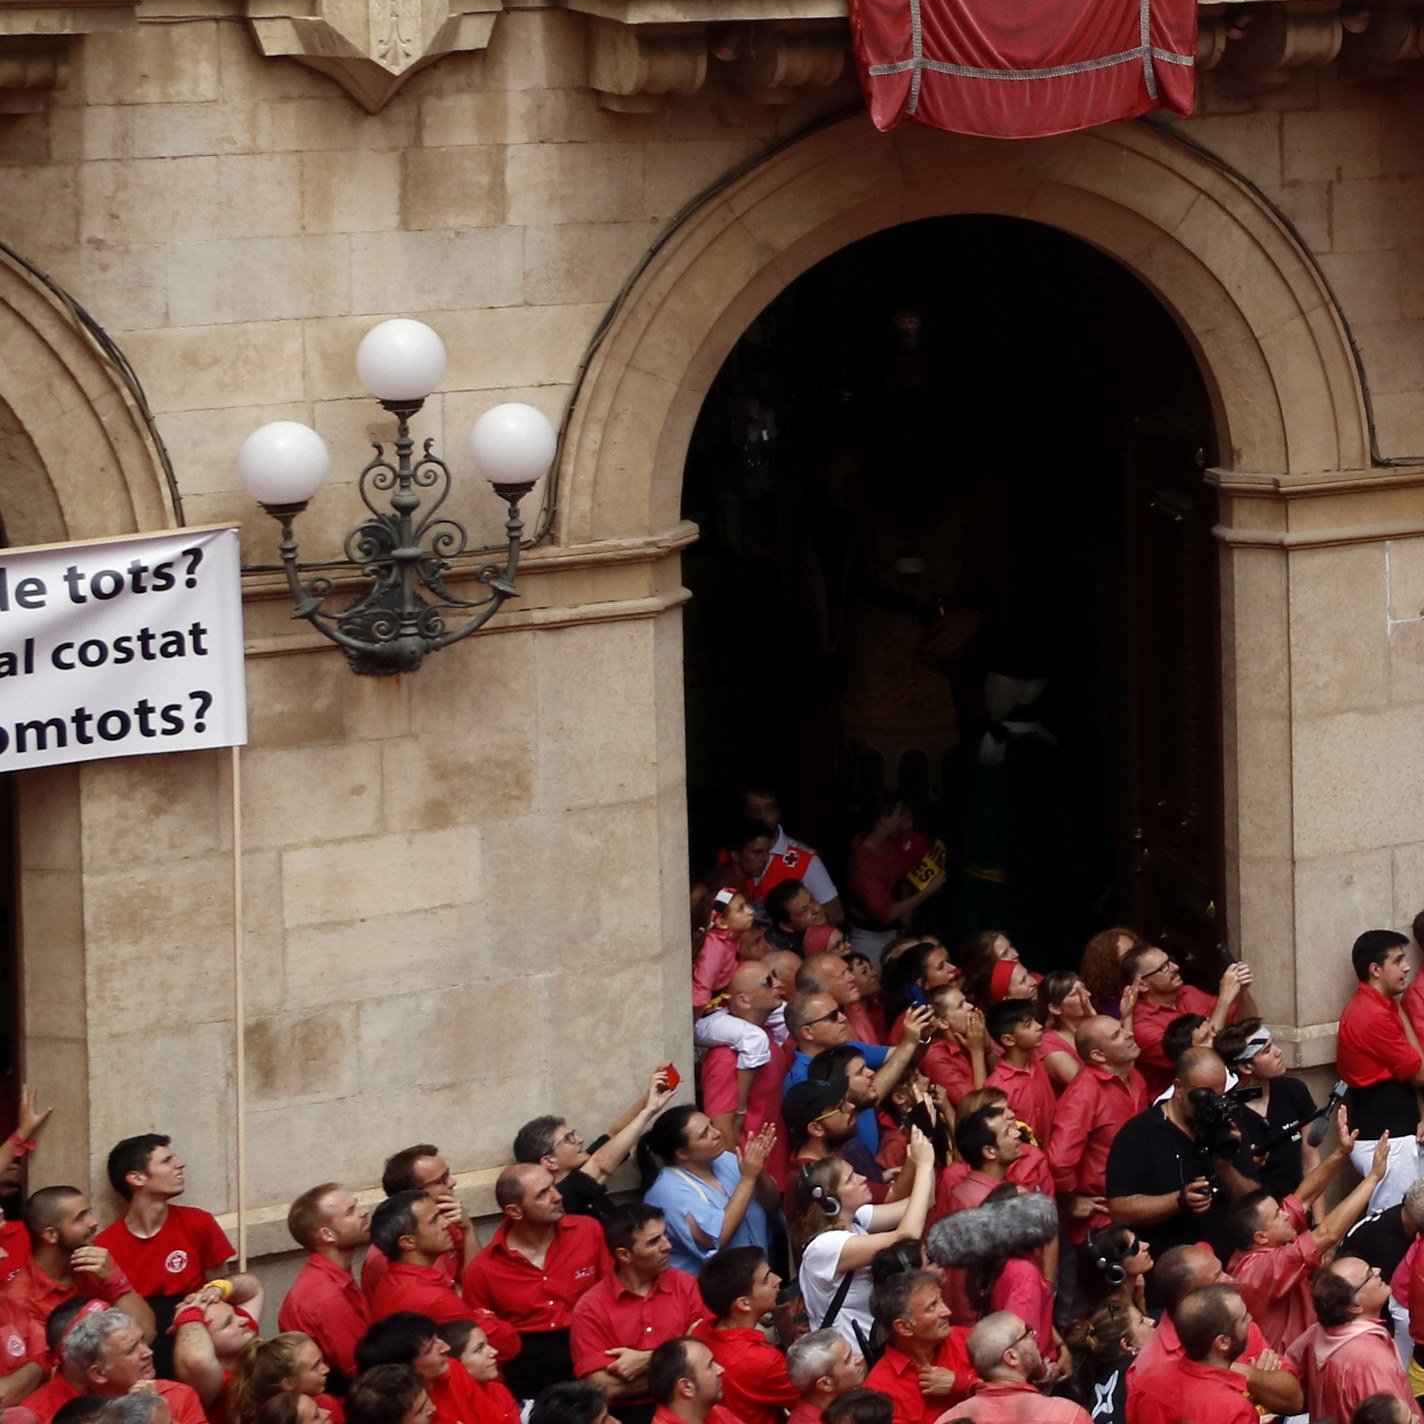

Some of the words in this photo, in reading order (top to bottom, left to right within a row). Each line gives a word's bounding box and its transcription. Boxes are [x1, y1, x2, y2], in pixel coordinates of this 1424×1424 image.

[0, 568, 48, 611] e
[63, 548, 203, 604] tots?
[51, 622, 208, 670] costat
[0, 691, 213, 755] mtots?
